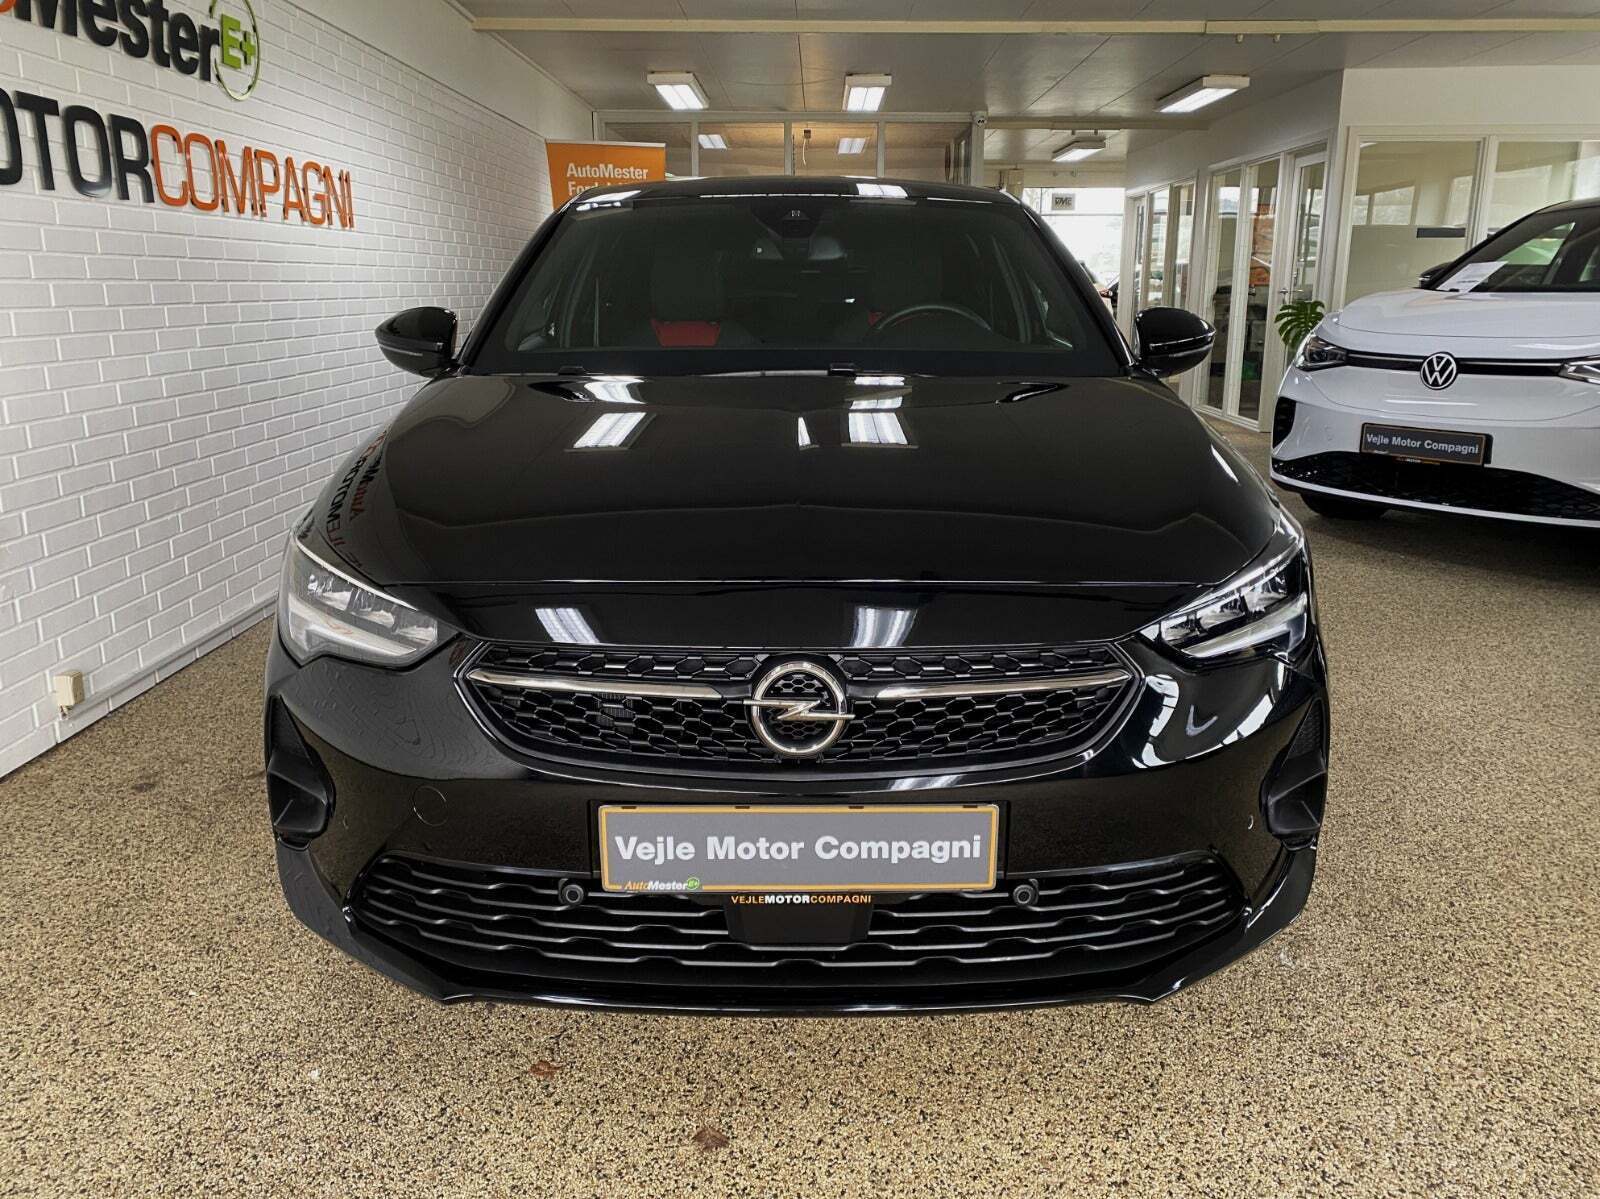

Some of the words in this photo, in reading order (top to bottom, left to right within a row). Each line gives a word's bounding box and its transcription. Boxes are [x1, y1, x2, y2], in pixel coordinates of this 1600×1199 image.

[0, 0, 219, 81] ester
[566, 162, 648, 180] AutoMester
[1366, 433, 1389, 445] Vejle
[1391, 436, 1421, 448] Motor
[1424, 439, 1479, 454] Compagni
[615, 837, 695, 865] Vejle
[707, 837, 804, 860] Motor
[815, 835, 981, 864] Compagni
